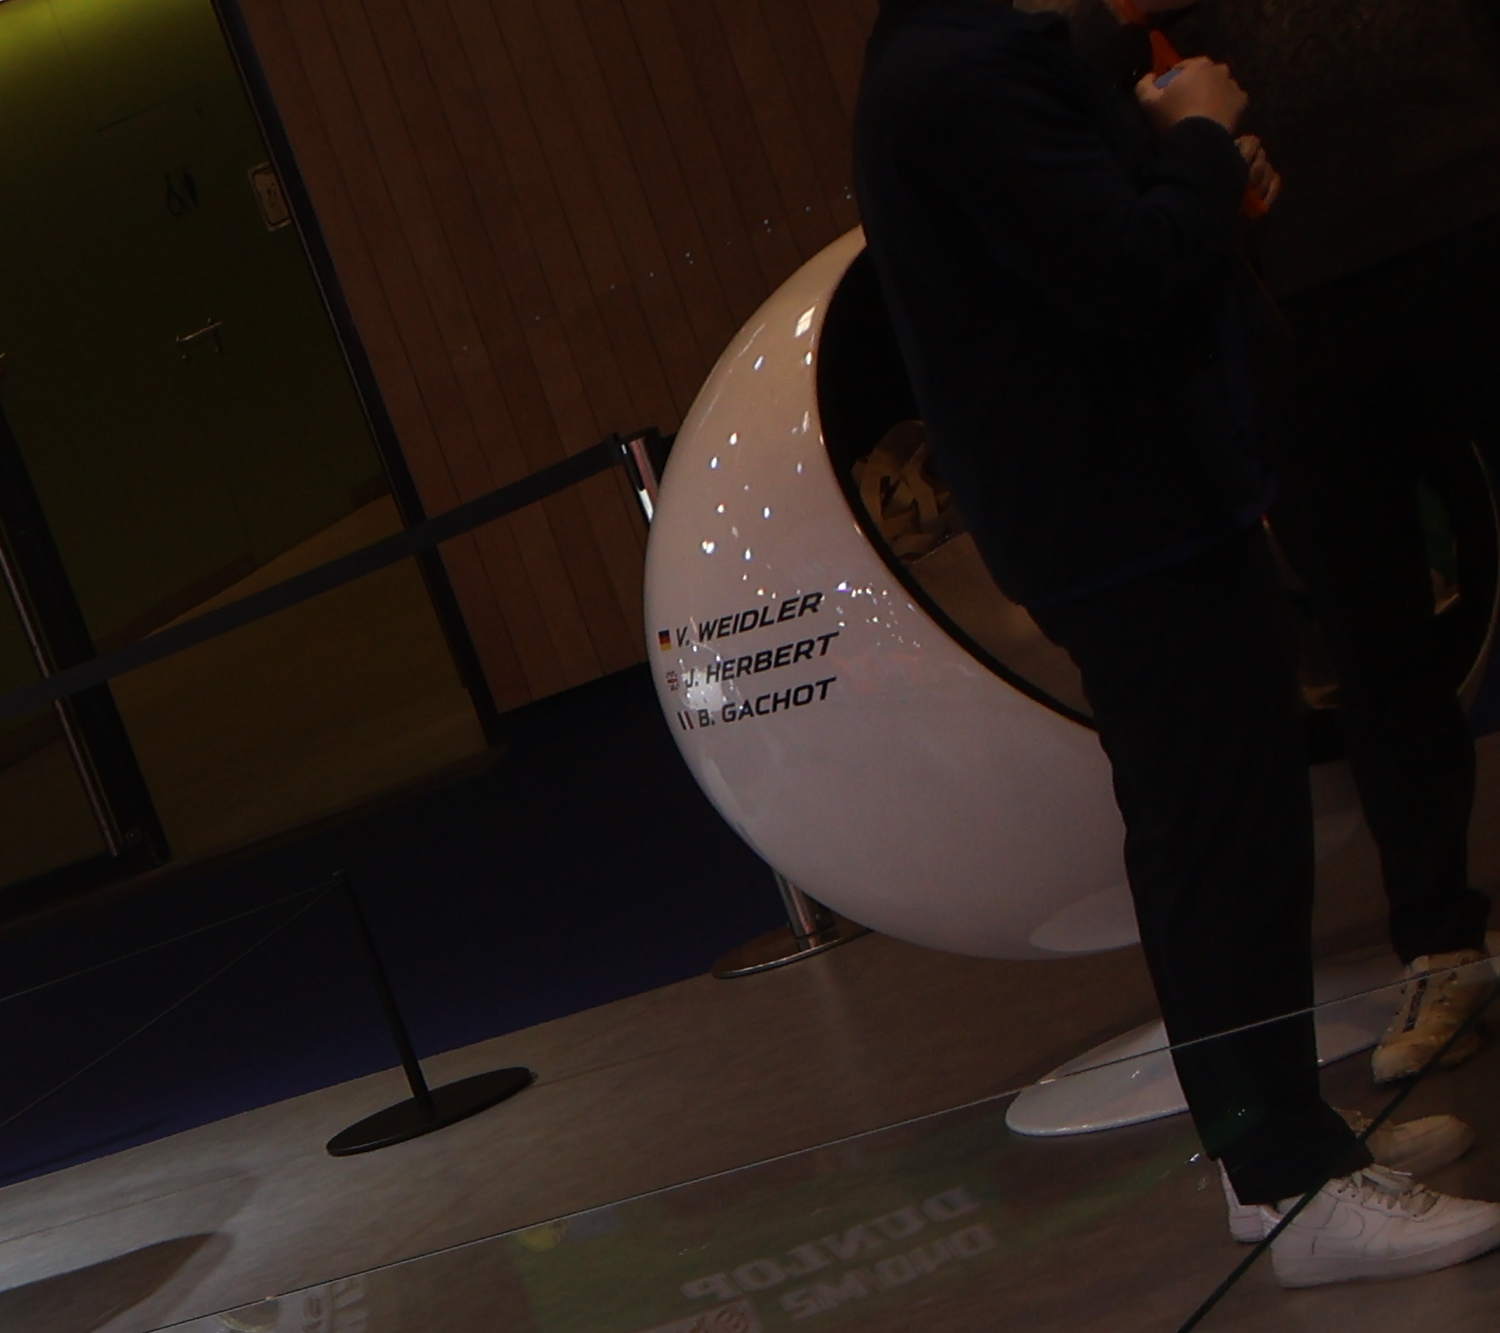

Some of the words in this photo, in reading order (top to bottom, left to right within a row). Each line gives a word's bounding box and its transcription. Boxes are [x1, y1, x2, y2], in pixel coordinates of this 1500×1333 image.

[676, 626, 691, 648] V.
[698, 591, 824, 642] WEIDLER
[685, 666, 699, 688] J.
[706, 631, 840, 685] HERBERT
[699, 708, 716, 728] B.
[721, 677, 838, 723] GACHOT
